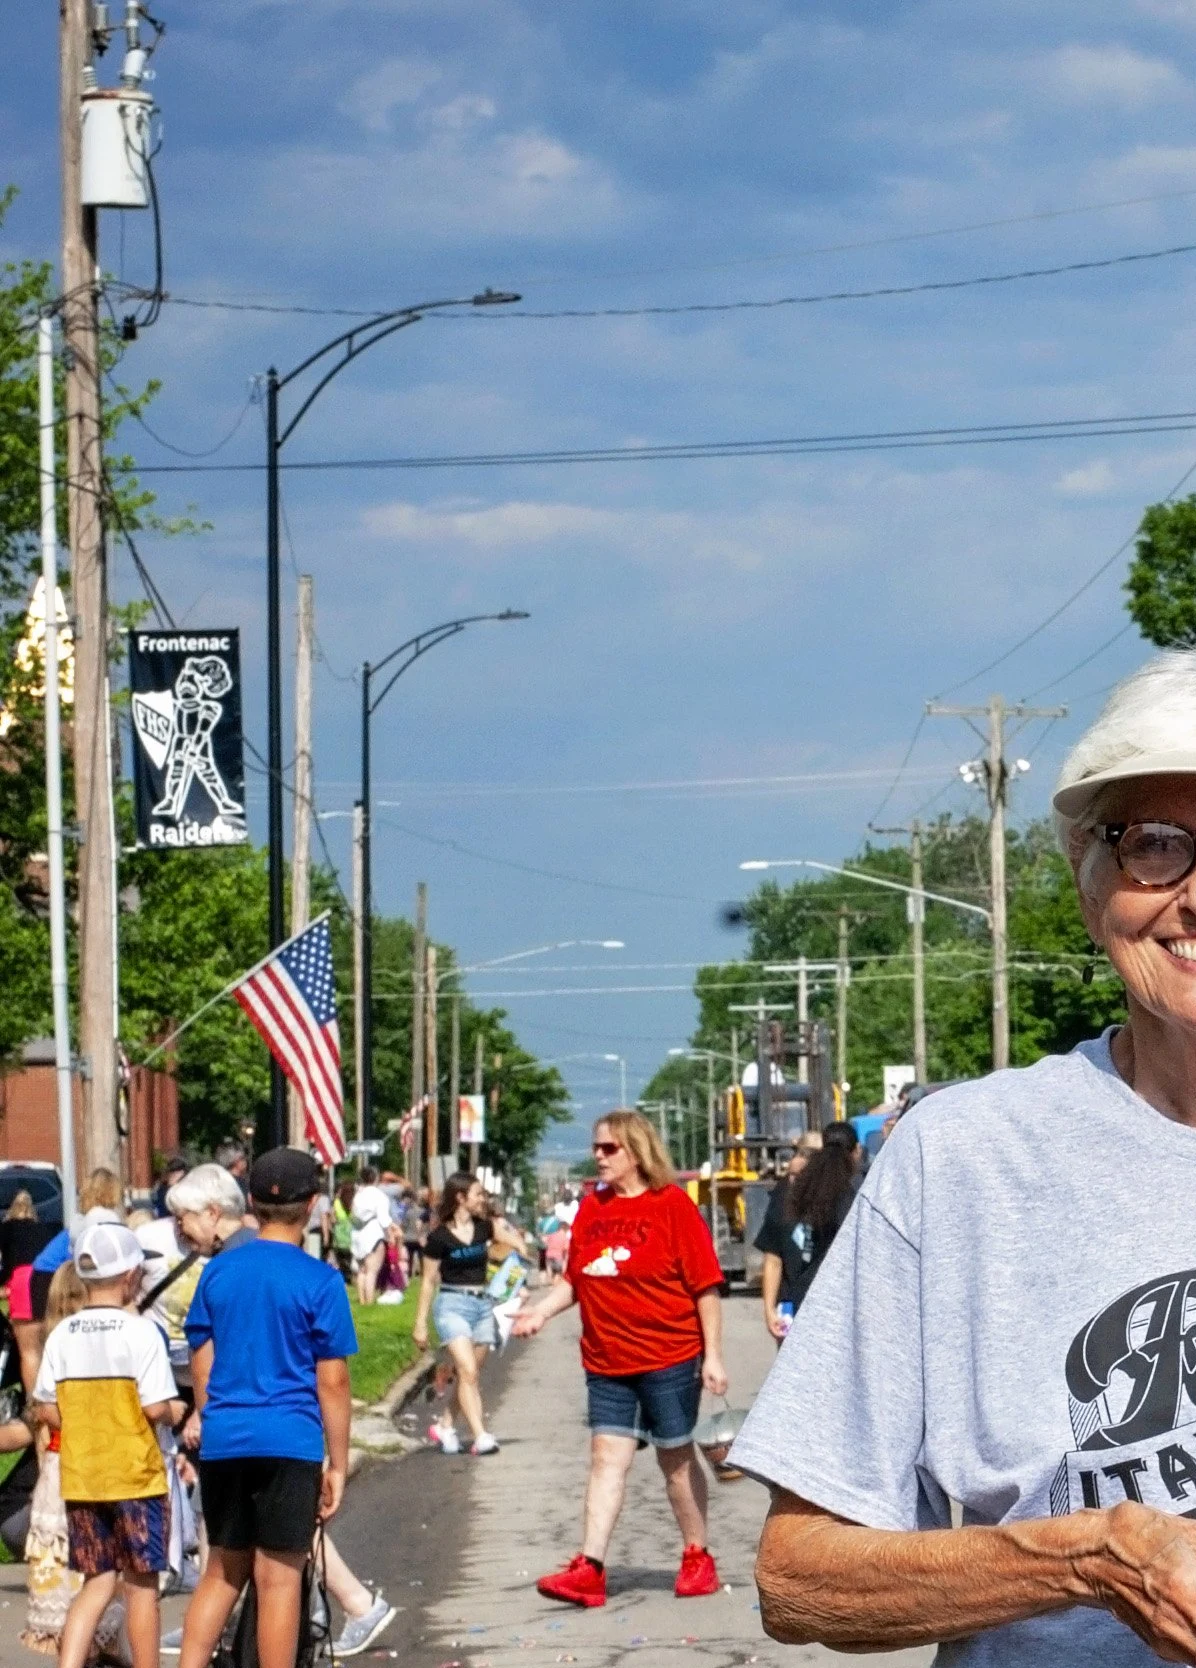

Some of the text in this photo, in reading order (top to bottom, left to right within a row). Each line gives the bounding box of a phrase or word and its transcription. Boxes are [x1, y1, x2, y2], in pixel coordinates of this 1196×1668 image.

[138, 635, 230, 652] Frontenac
[138, 705, 169, 741] FHS
[150, 821, 236, 845] Raide
